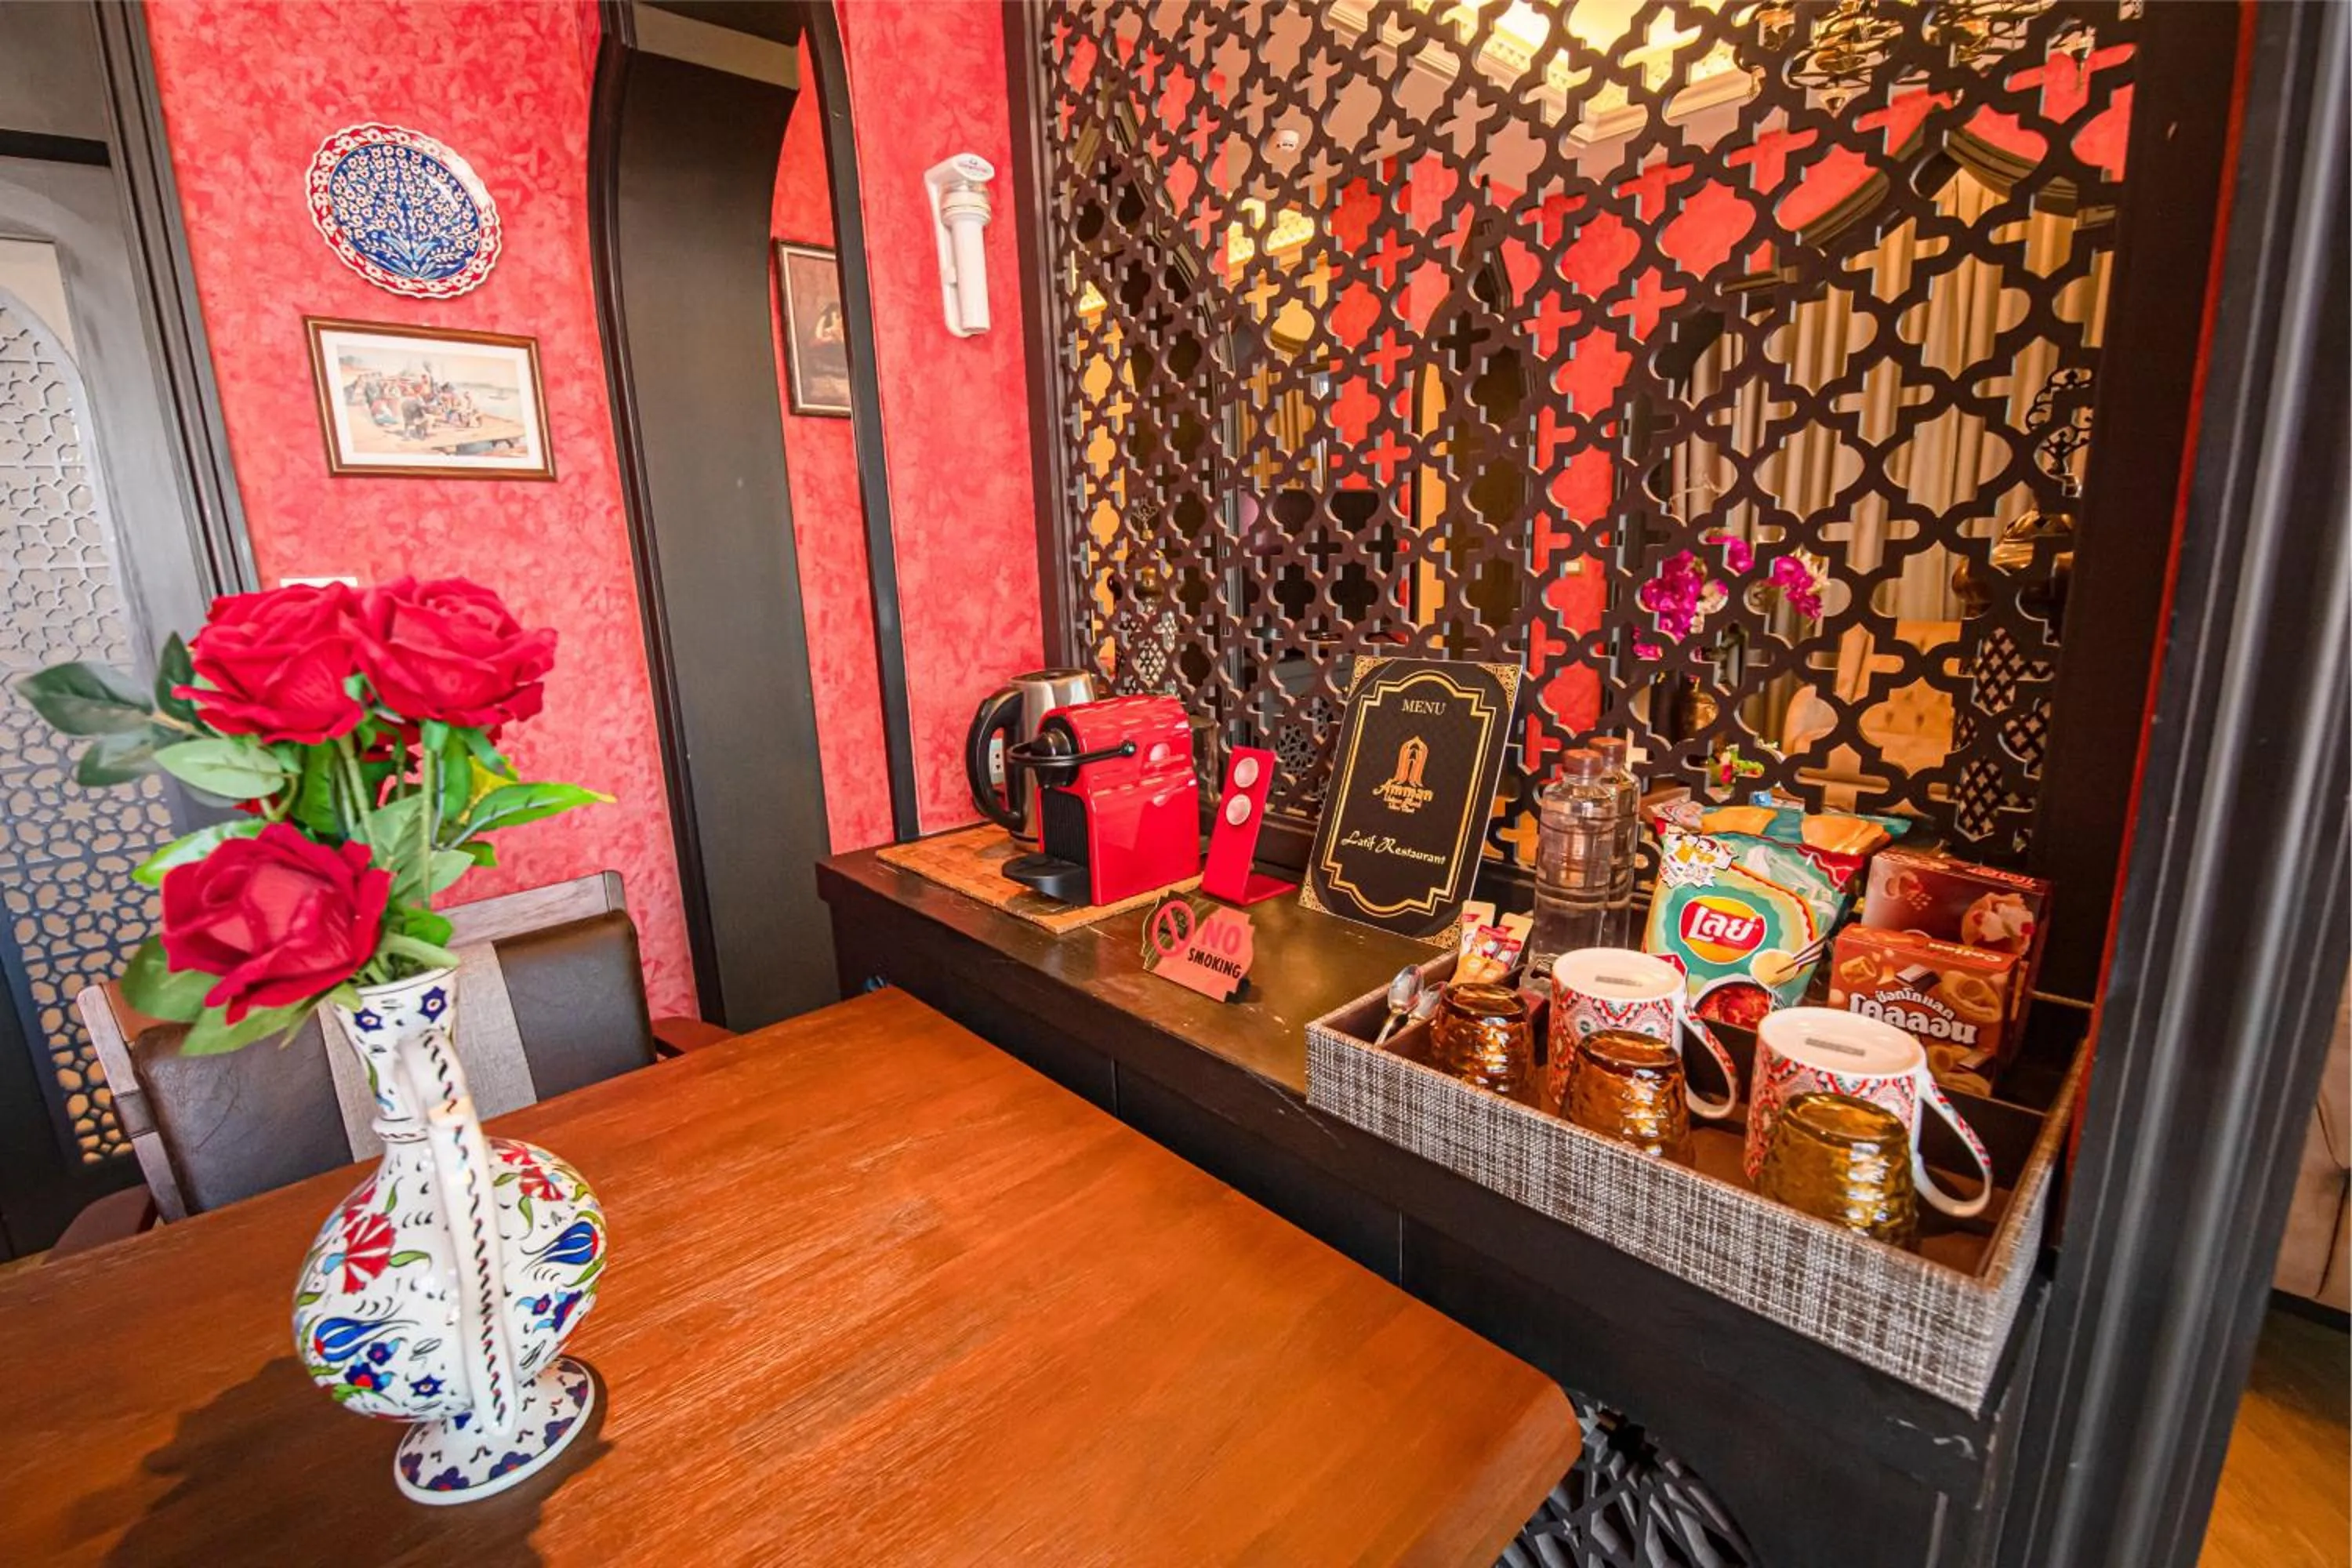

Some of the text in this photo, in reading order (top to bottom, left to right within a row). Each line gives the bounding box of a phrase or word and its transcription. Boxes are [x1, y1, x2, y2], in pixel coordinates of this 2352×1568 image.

[1401, 698, 1446, 715] MENU
[1341, 830, 1446, 865] Latif Restaurant
[1201, 916, 1243, 956] NO
[1688, 905, 1756, 942] เลย์
[1187, 946, 1243, 979] SMOKING
[1849, 992, 1978, 1044] โคลลอน
